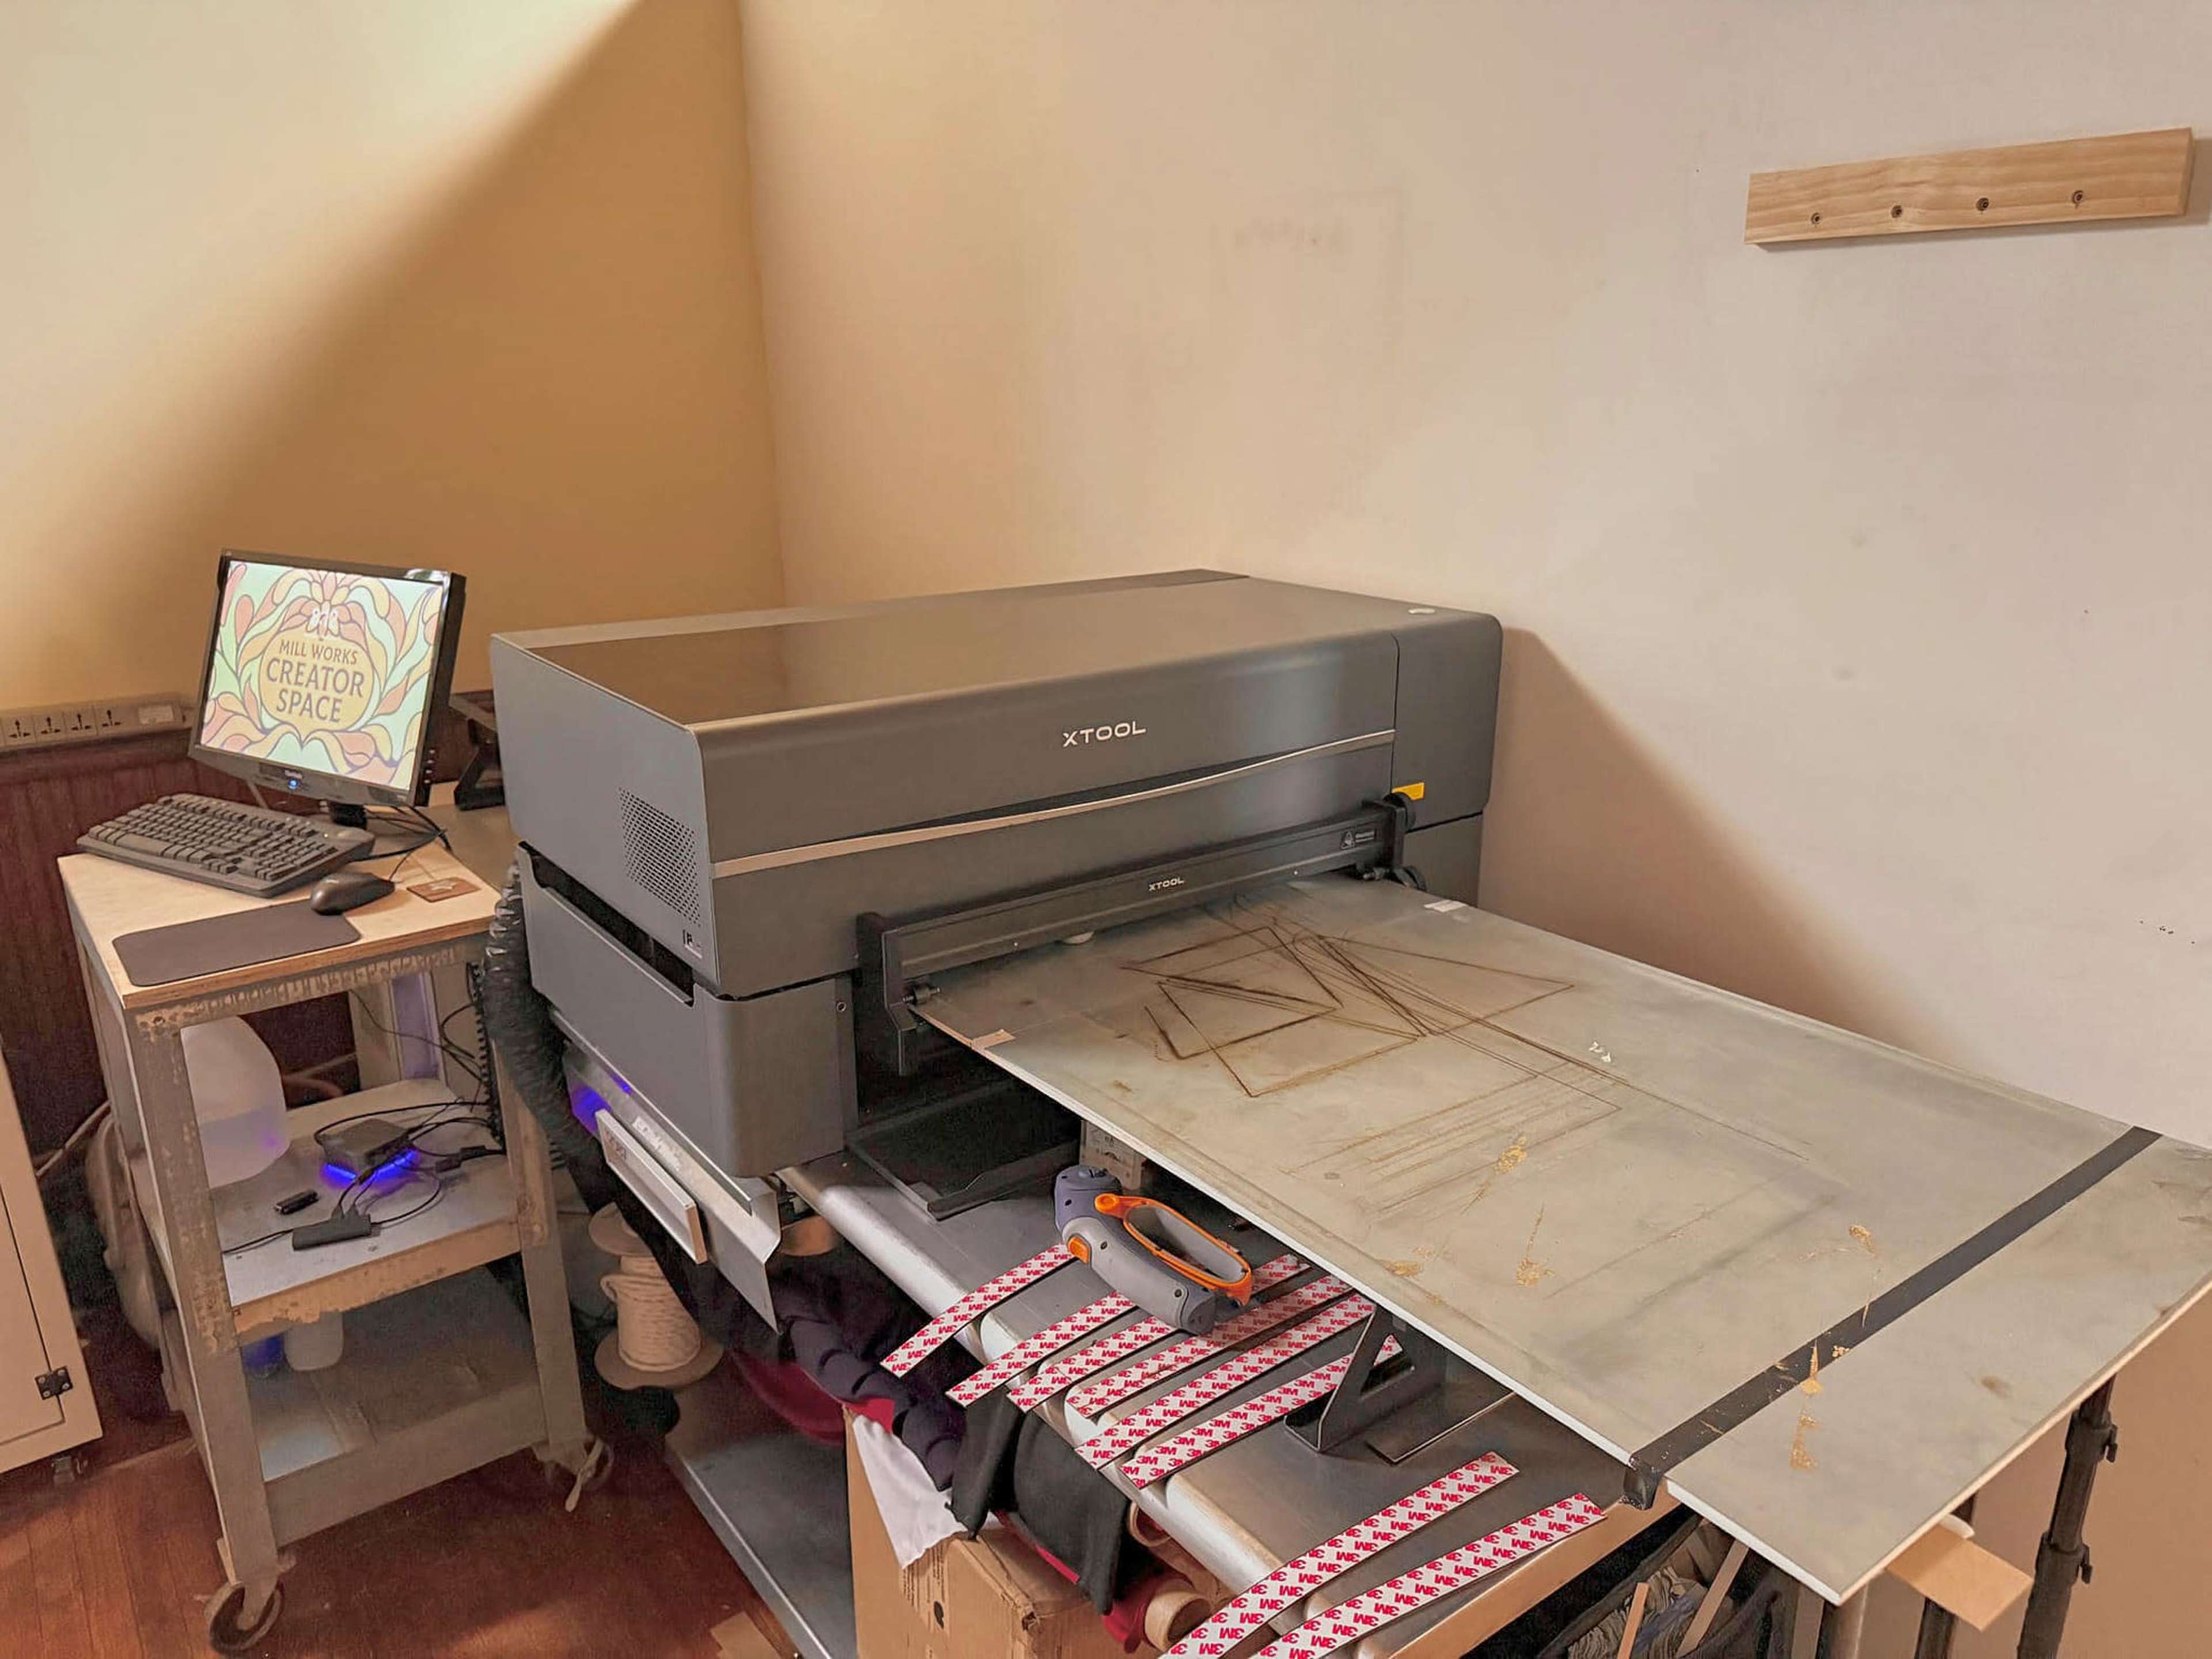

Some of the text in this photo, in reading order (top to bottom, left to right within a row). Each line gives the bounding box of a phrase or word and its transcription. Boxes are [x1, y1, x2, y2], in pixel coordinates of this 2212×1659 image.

[279, 639, 358, 665] MILL WORKS
[267, 657, 365, 698] CREATOR
[276, 688, 342, 722] SPACE
[1063, 721, 1146, 747] XTOOL
[1149, 877, 1185, 892] XTOOL
[1150, 1326, 1170, 1334] 3M
[1244, 1365, 1263, 1373] 3M
[992, 1372, 1011, 1380] 3M
[1051, 1376, 1072, 1385] 3M
[1310, 1372, 1331, 1381] 3M
[975, 1382, 995, 1391] 3M
[1034, 1387, 1054, 1395] 3M
[1278, 1387, 1298, 1395] 3M
[958, 1393, 978, 1401] 3M
[1107, 1388, 1127, 1396] 3M
[1017, 1398, 1037, 1406] 3M
[1089, 1397, 1109, 1406] 3M
[1262, 1395, 1281, 1403] 3M
[1244, 1403, 1264, 1411] 3M
[1209, 1419, 1230, 1428] 3M
[1129, 1429, 1149, 1437] 3M
[1191, 1428, 1213, 1437] 3M
[1111, 1440, 1132, 1448] 3M
[1173, 1437, 1195, 1445] 3M
[1093, 1450, 1115, 1459] 3M
[1156, 1446, 1177, 1455] 3M
[1137, 1456, 1158, 1464] 3M
[1491, 1465, 1513, 1475] 3M
[1475, 1475, 1497, 1484] 3M
[1458, 1483, 1480, 1494] 3M
[1441, 1493, 1463, 1502] 3M
[1426, 1502, 1448, 1512] 3M
[1408, 1512, 1431, 1521] 3M
[1566, 1513, 1590, 1524] 3M
[1391, 1521, 1414, 1531] 3M
[1548, 1522, 1571, 1533] 3M
[1373, 1531, 1396, 1541] 3M
[1530, 1529, 1554, 1541] 3M
[1355, 1541, 1378, 1552] 3M
[1512, 1539, 1535, 1550] 3M
[1336, 1552, 1360, 1562] 3M
[1493, 1547, 1517, 1559] 3M
[1318, 1562, 1342, 1573] 3M
[1474, 1556, 1498, 1569] 3M
[1455, 1565, 1479, 1577] 3M
[1299, 1573, 1323, 1584] 3M
[1434, 1574, 1459, 1587] 3M
[1279, 1585, 1304, 1597] 3M
[1415, 1584, 1440, 1596] 3M
[1259, 1599, 1284, 1609] 3M
[1395, 1593, 1419, 1606] 3M
[1374, 1603, 1399, 1616] 3M
[1240, 1612, 1264, 1624] 3M
[1353, 1613, 1378, 1626] 3M
[1219, 1628, 1244, 1639] 3M
[1332, 1624, 1358, 1637] 3M
[1311, 1635, 1337, 1648] 3M
[1199, 1643, 1225, 1655] 3M
[1289, 1649, 1315, 1659] 3M
